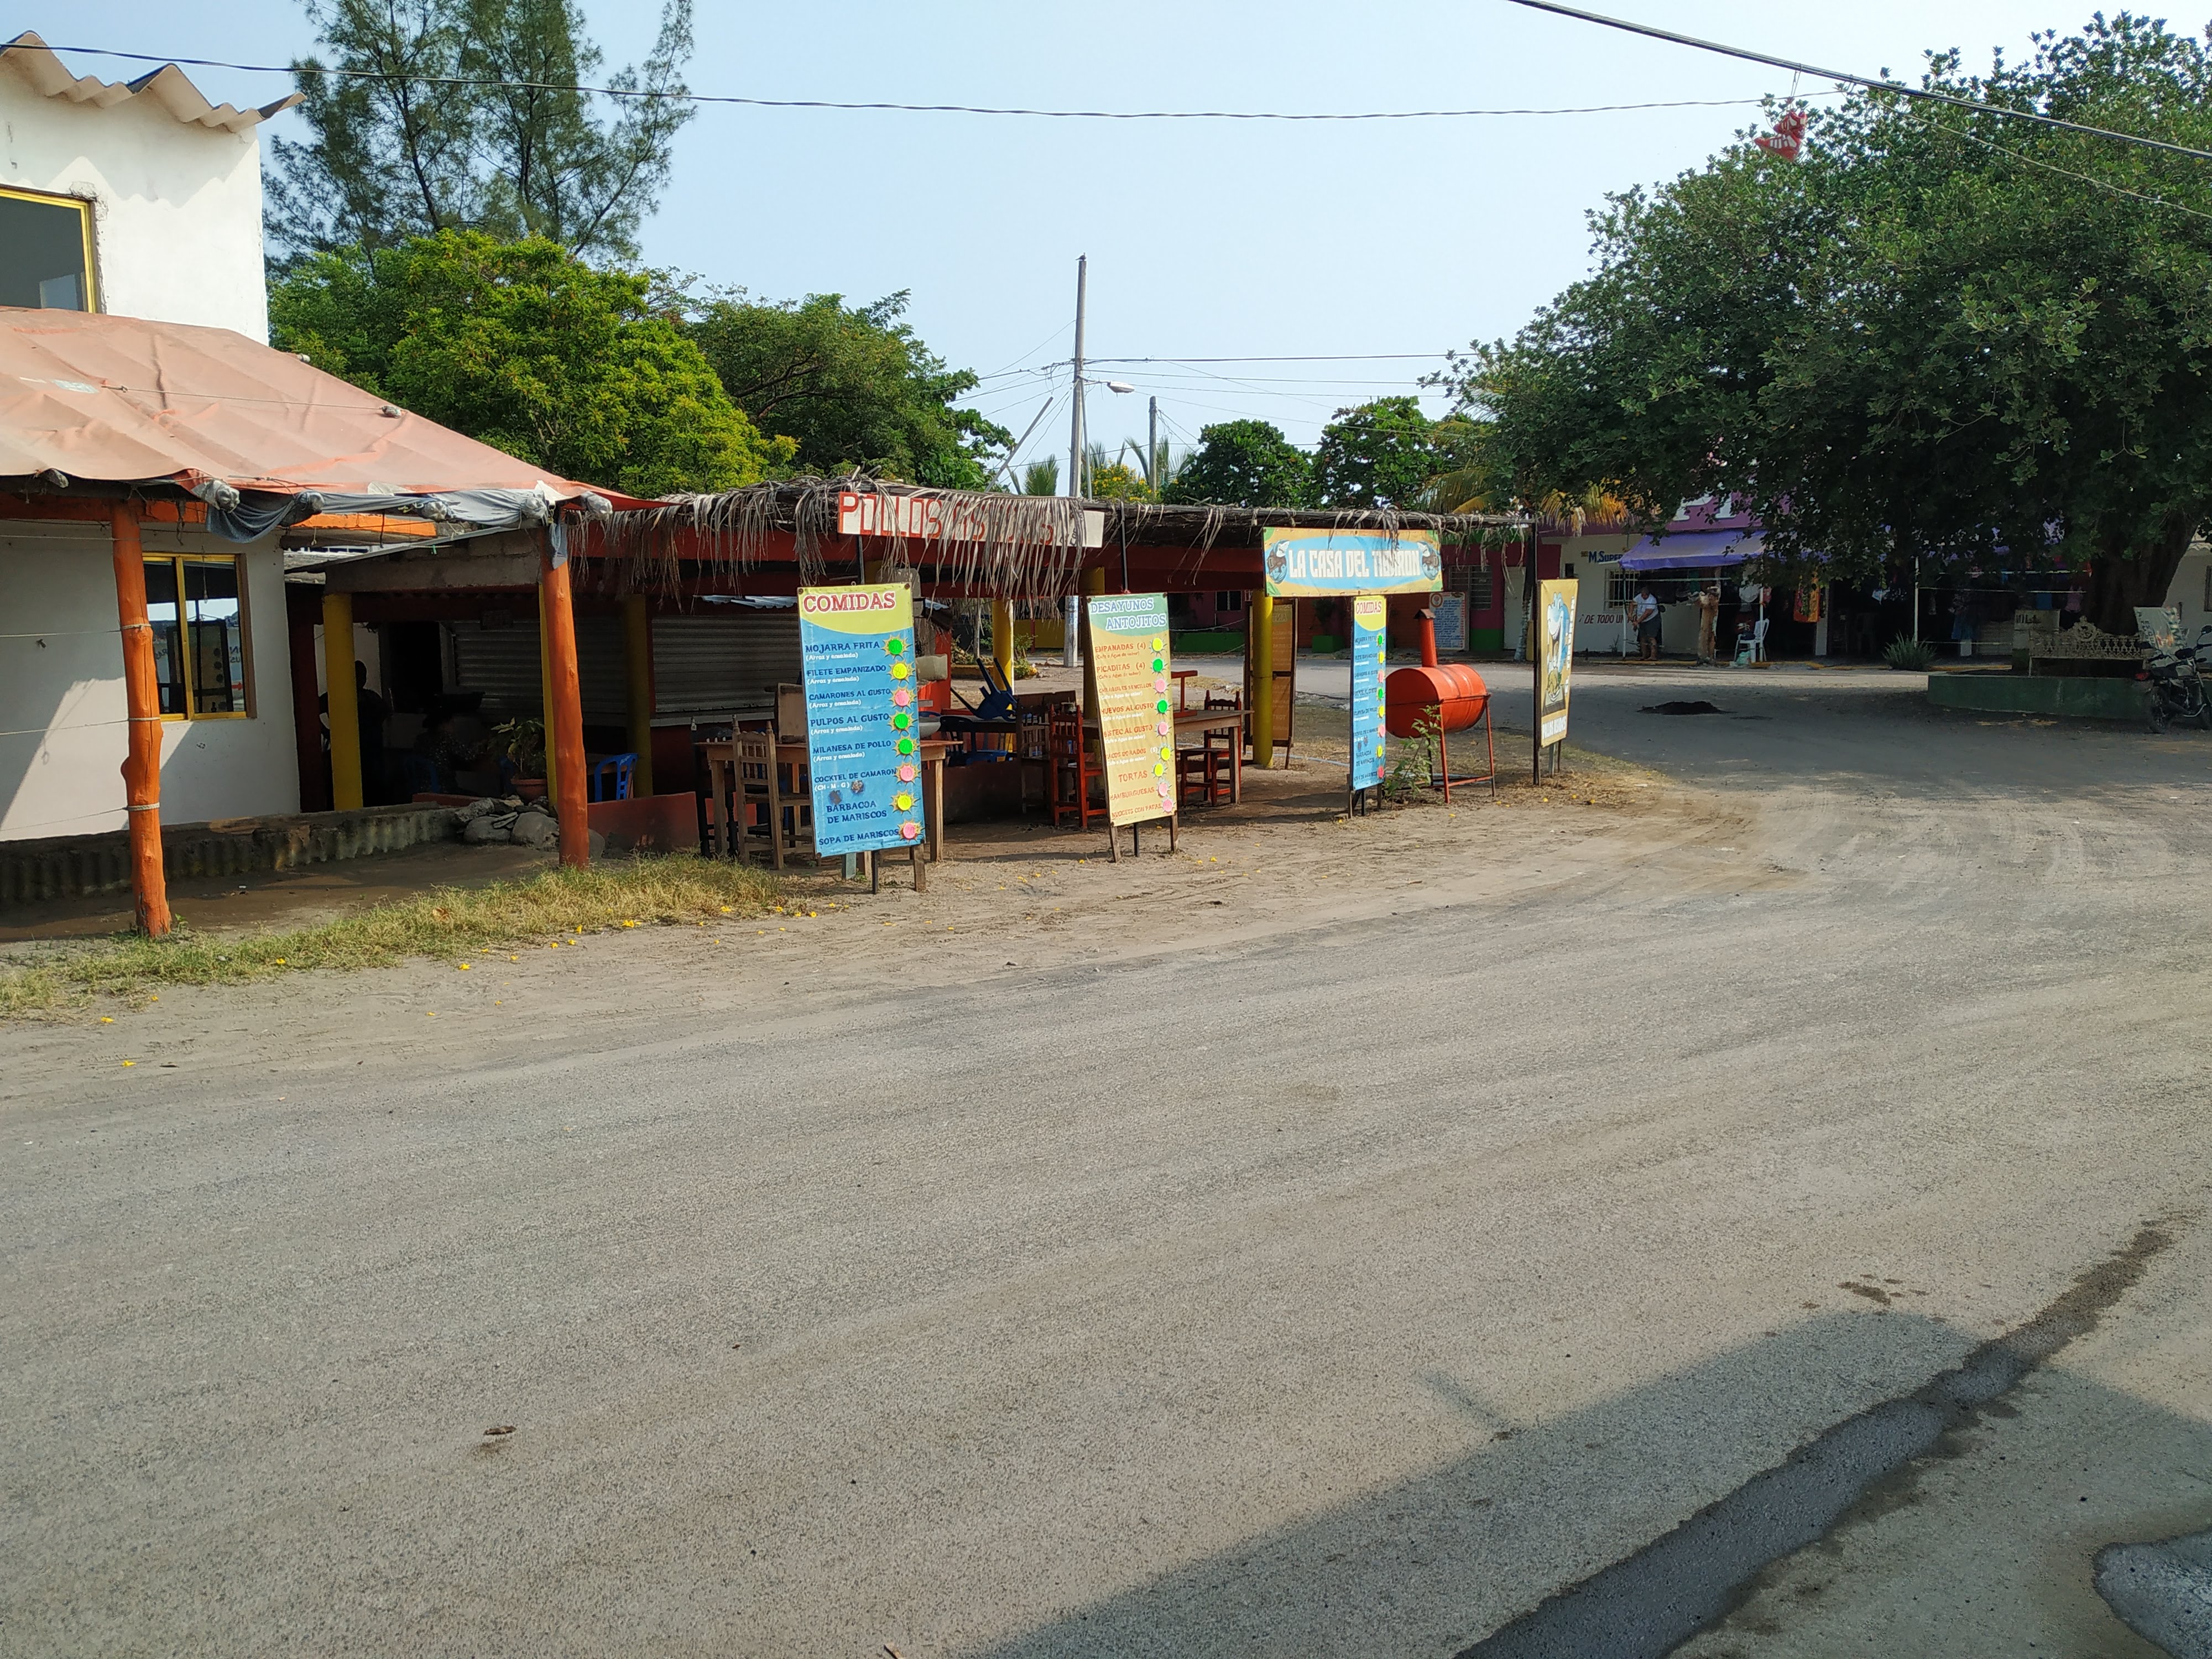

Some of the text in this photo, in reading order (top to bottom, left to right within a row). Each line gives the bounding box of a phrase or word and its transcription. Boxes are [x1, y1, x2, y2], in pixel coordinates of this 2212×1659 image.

[838, 492, 942, 538] POLLOS
[1288, 549, 1306, 578] LA
[1310, 550, 1342, 578] CASA
[1346, 550, 1369, 577] DEL
[804, 593, 895, 612] COMIDAS
[1091, 599, 1153, 613] DESAYUNOS
[1356, 601, 1381, 614] COMIDAS
[1107, 615, 1166, 629] ANTOJITOS
[1597, 615, 1614, 623] TODO
[805, 641, 880, 653] MOJARRA FRITA
[1095, 644, 1133, 653] EMPANADAS
[836, 665, 886, 675] EMPANIZADO
[1097, 664, 1130, 673] PICADITAS
[809, 692, 854, 700] CAMARONES
[810, 713, 889, 727] PULPOS AL GUSTO
[1134, 724, 1152, 733] GUSTO
[813, 744, 853, 754] MILANESA
[815, 774, 846, 783] COCKTEL
[861, 769, 896, 778] CAMARON
[1119, 770, 1147, 782] TORTAS
[827, 801, 877, 812] BARBACOA
[827, 810, 887, 823] DE MARISCOS
[819, 835, 841, 845] SOPA
[858, 828, 899, 840] MARISCOS
